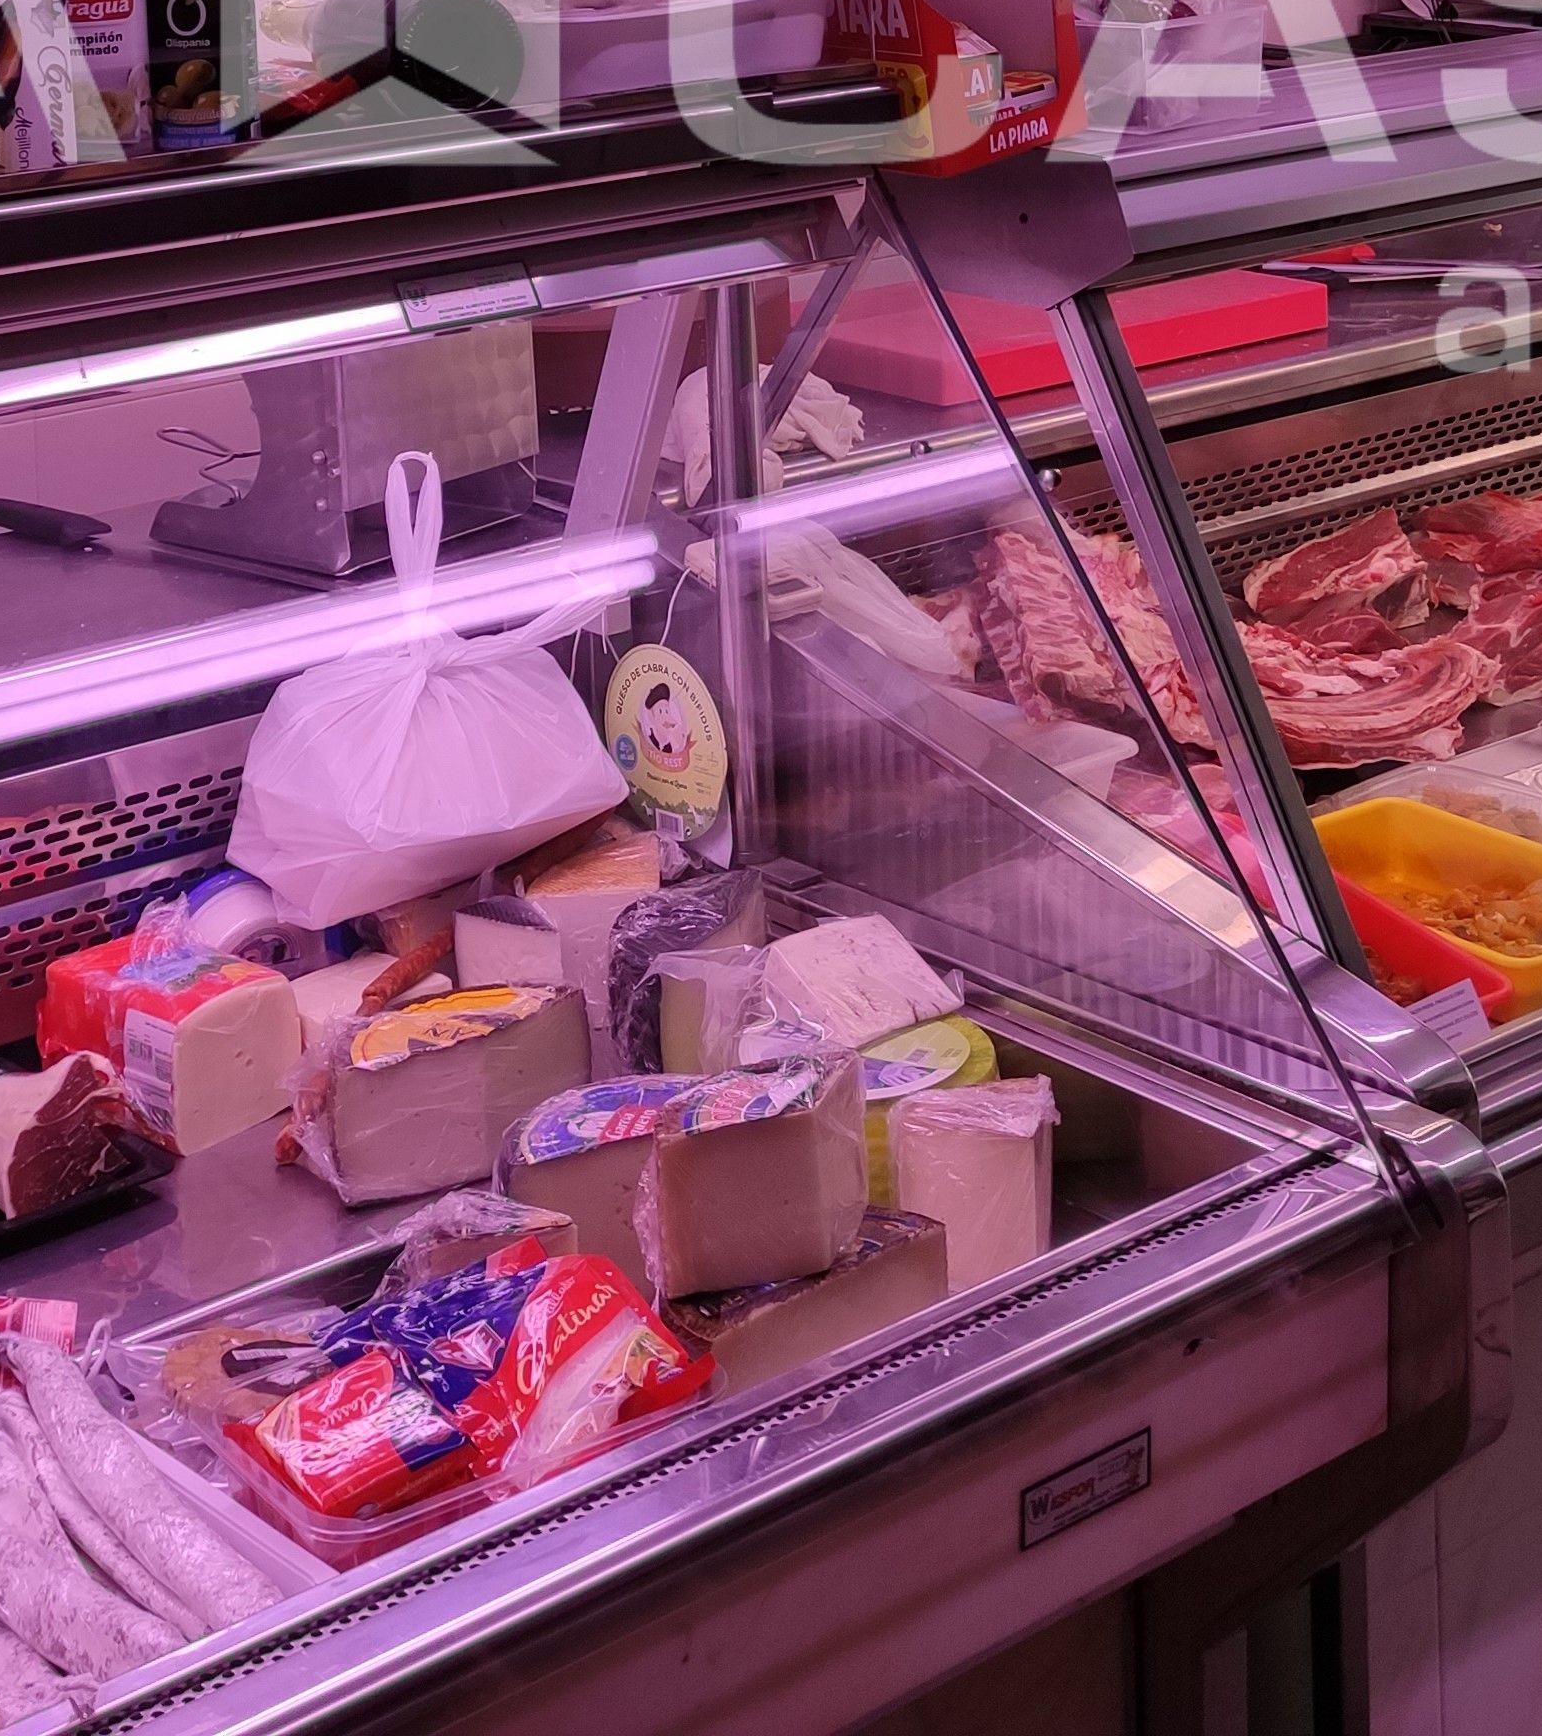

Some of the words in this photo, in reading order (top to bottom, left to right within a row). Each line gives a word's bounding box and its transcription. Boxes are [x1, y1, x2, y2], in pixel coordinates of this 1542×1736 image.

[69, 32, 123, 45] mpiñón
[69, 44, 120, 57] minado
[16, 106, 30, 170] Mejillon
[990, 128, 1006, 154] LA
[1009, 116, 1049, 149] PIARA
[616, 678, 631, 715] QUESO
[630, 668, 642, 682] DE
[641, 663, 670, 676] CABRA
[671, 671, 690, 694] CON
[690, 692, 713, 743] BIFIDUS
